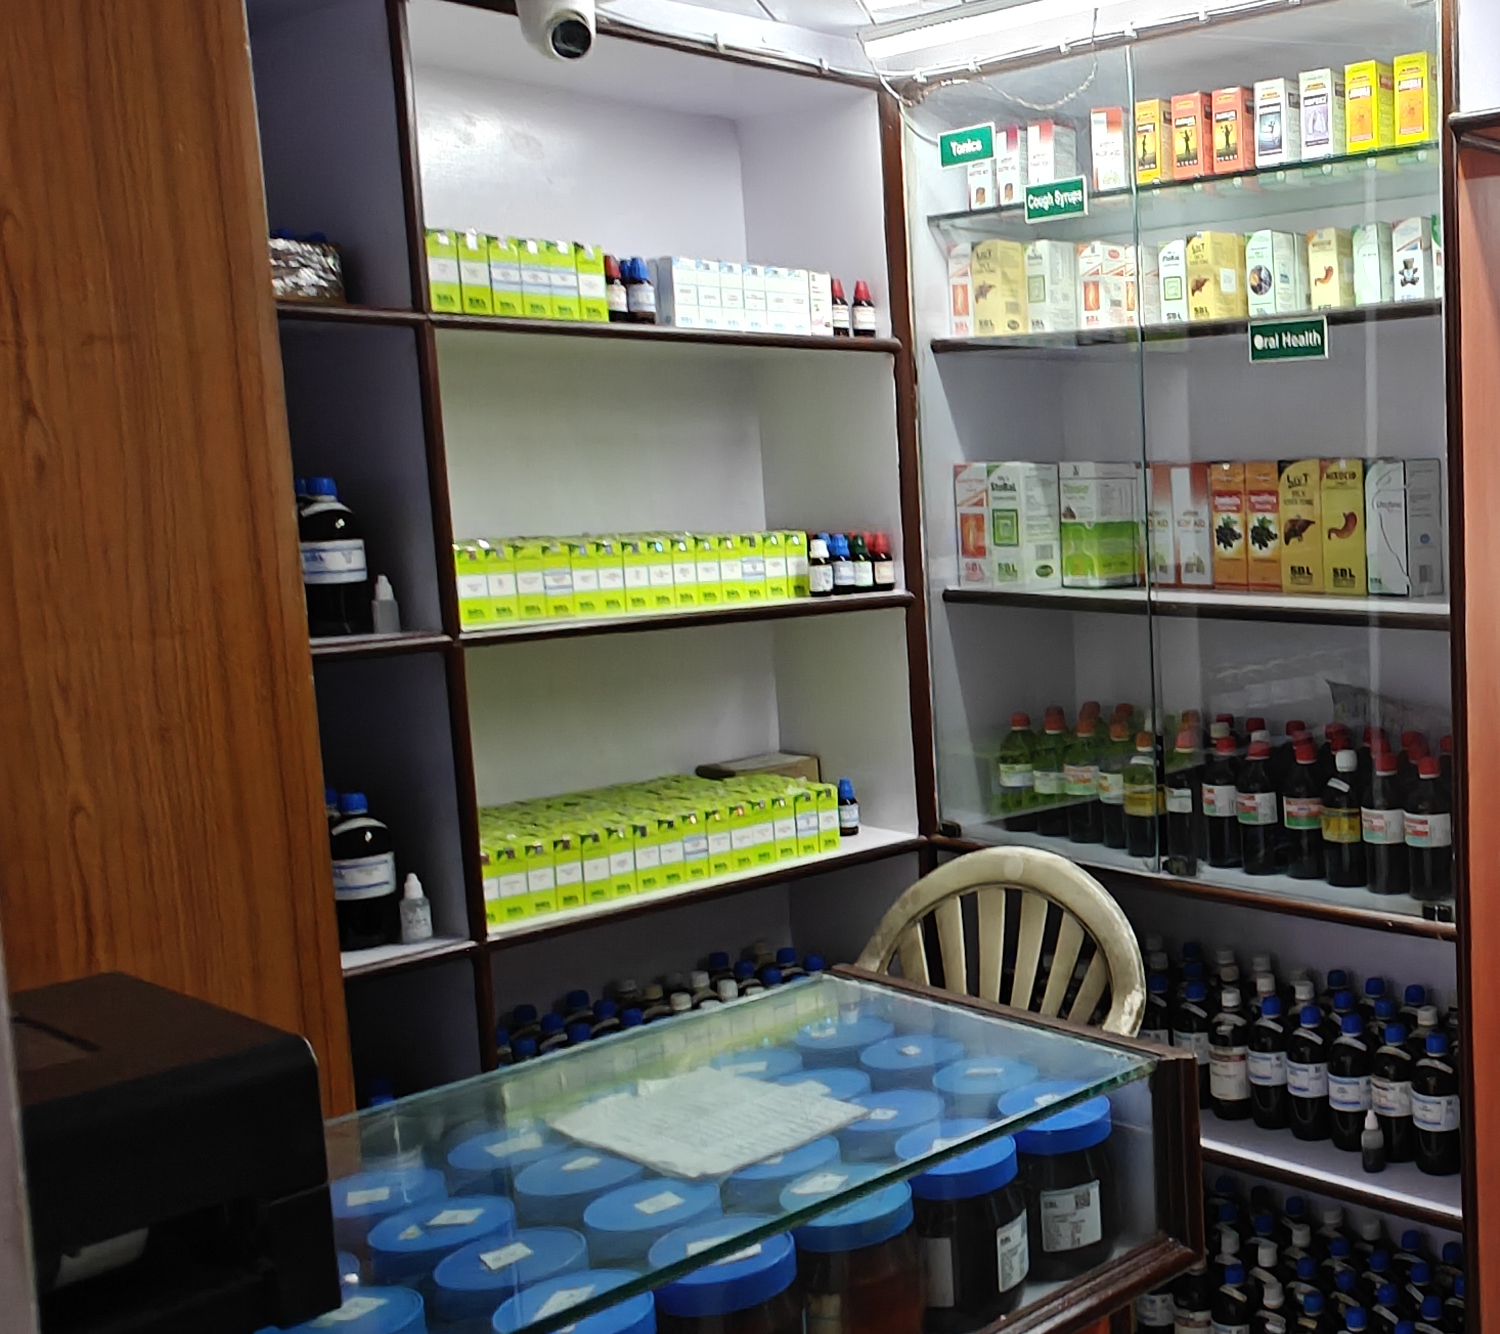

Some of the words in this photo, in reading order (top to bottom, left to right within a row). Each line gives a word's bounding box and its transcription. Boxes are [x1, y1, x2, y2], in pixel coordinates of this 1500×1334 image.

[950, 138, 983, 157] Tonics
[1028, 193, 1054, 211] Cough
[1054, 189, 1083, 208] Syrups
[1254, 332, 1279, 350] Oral
[1282, 329, 1322, 349] Health
